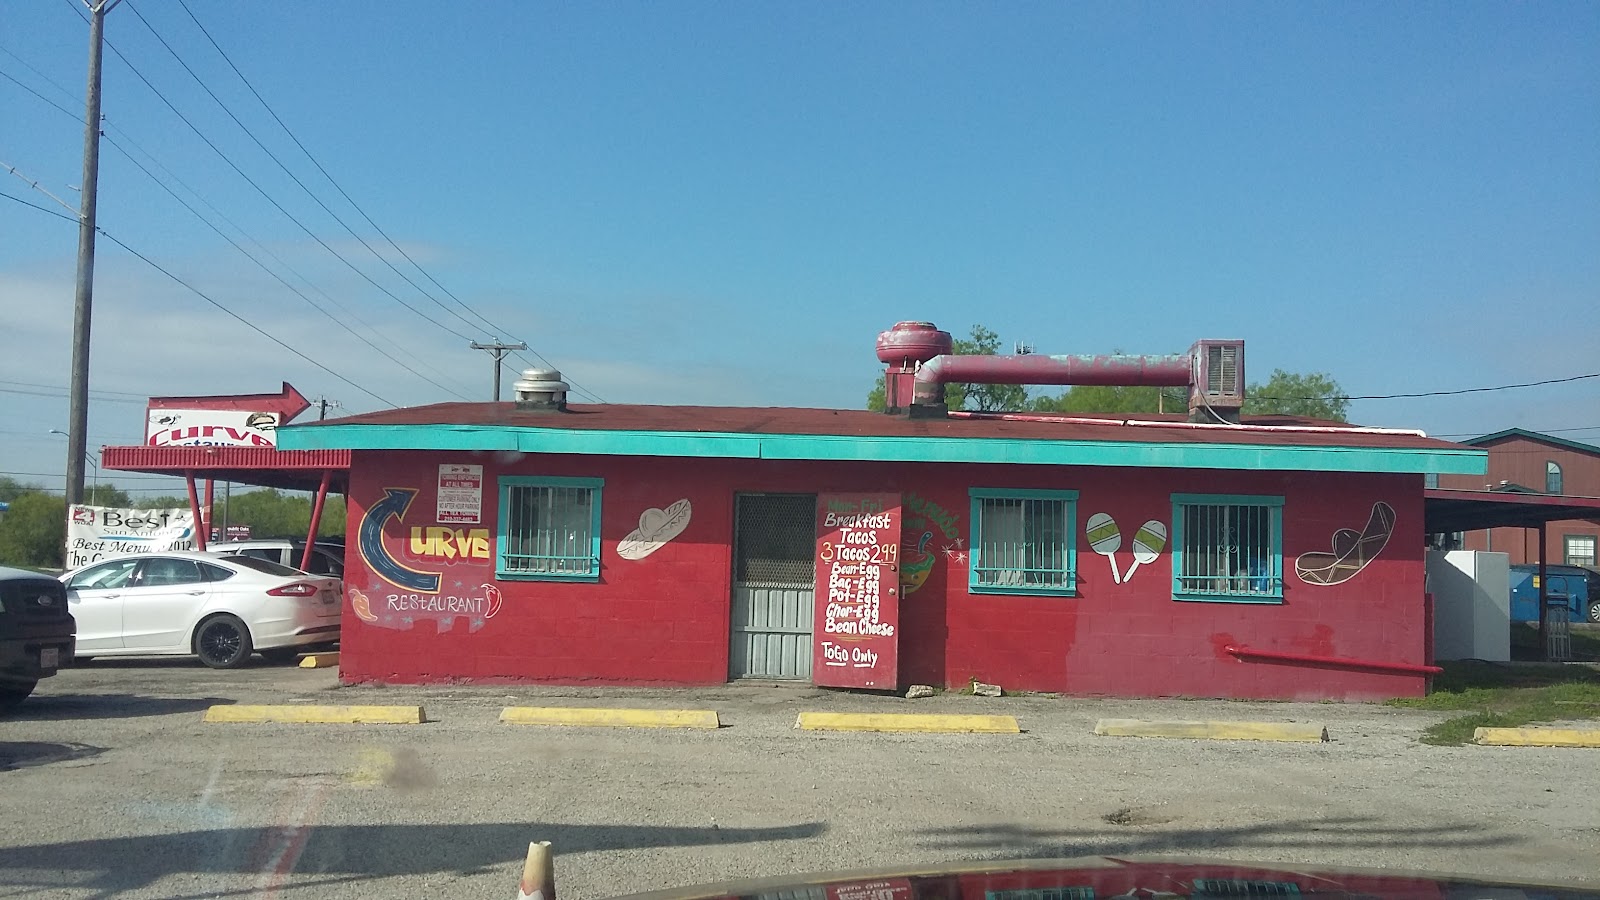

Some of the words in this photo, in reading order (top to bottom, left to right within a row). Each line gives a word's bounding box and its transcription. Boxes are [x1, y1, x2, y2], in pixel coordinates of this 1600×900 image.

[149, 425, 274, 447] Curve
[103, 511, 170, 529] Best
[824, 512, 892, 529] Breakfast
[73, 538, 105, 551] Best
[840, 528, 877, 545] Tacos
[820, 541, 834, 560] 3
[835, 544, 871, 561] Tacos
[825, 617, 858, 634] Bean
[852, 647, 878, 669] Only
